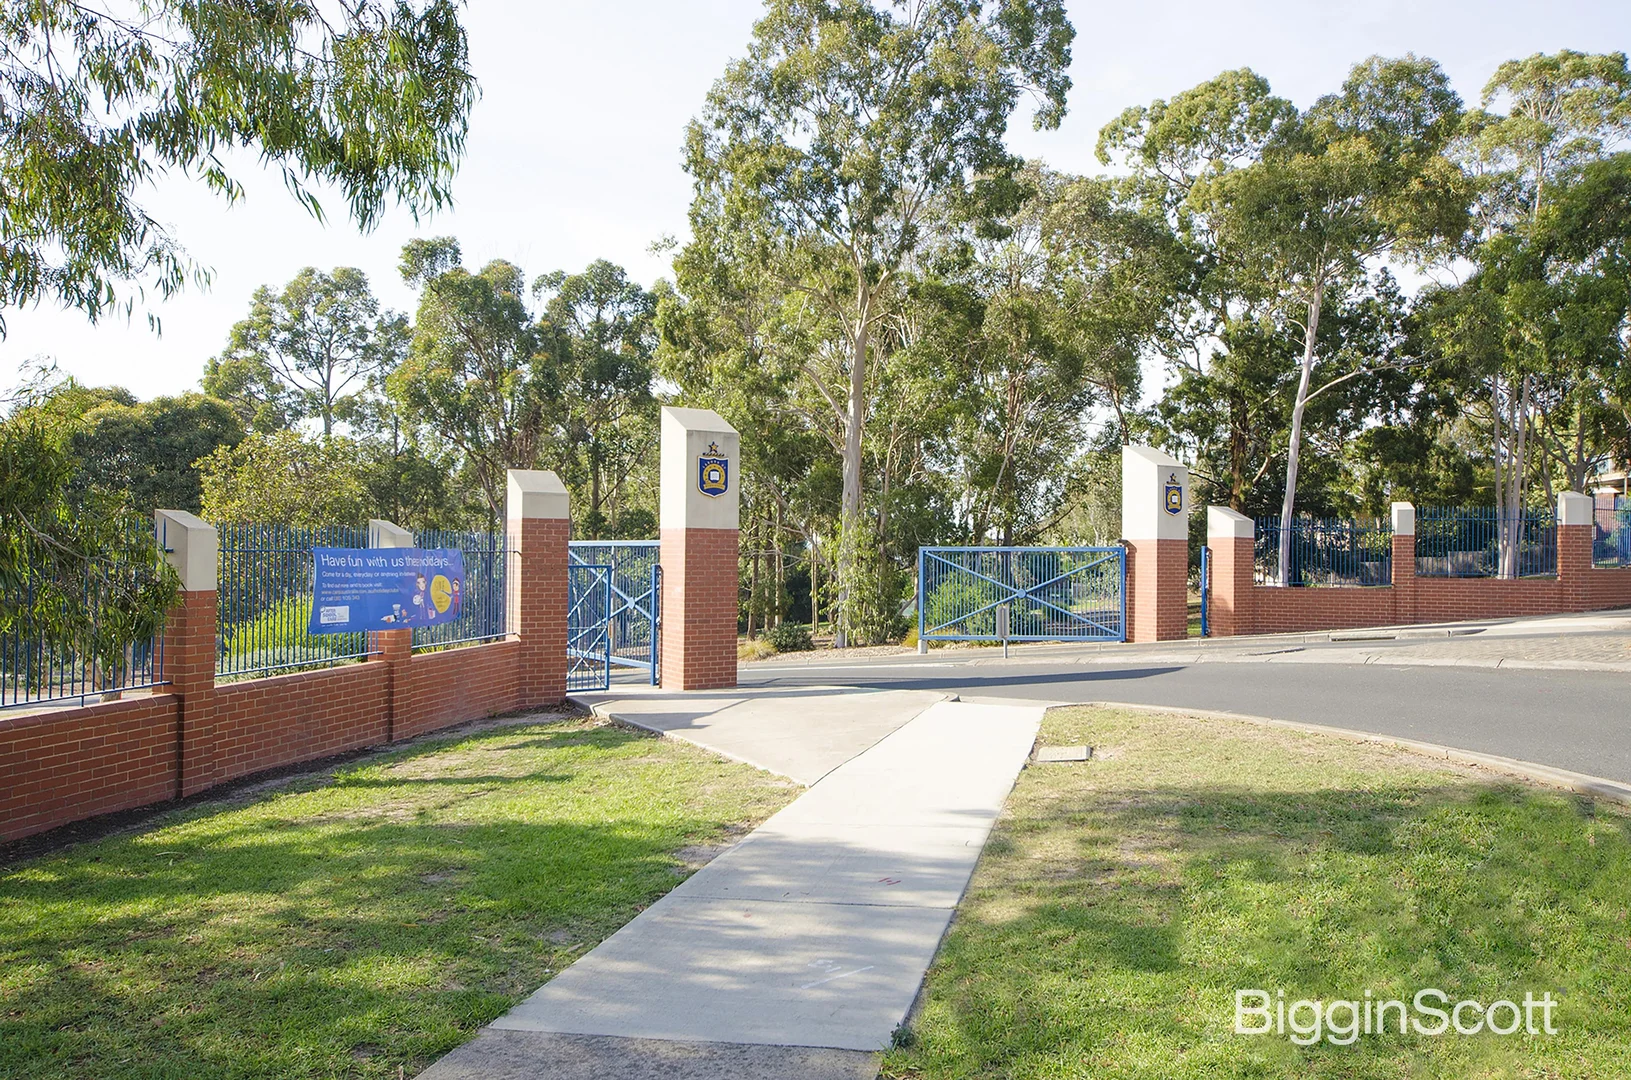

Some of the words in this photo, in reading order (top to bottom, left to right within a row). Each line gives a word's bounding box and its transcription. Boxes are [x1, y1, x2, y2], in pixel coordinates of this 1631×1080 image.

[320, 554, 346, 566] Have
[348, 554, 363, 567] fun
[366, 556, 388, 567] with
[391, 558, 404, 567] us
